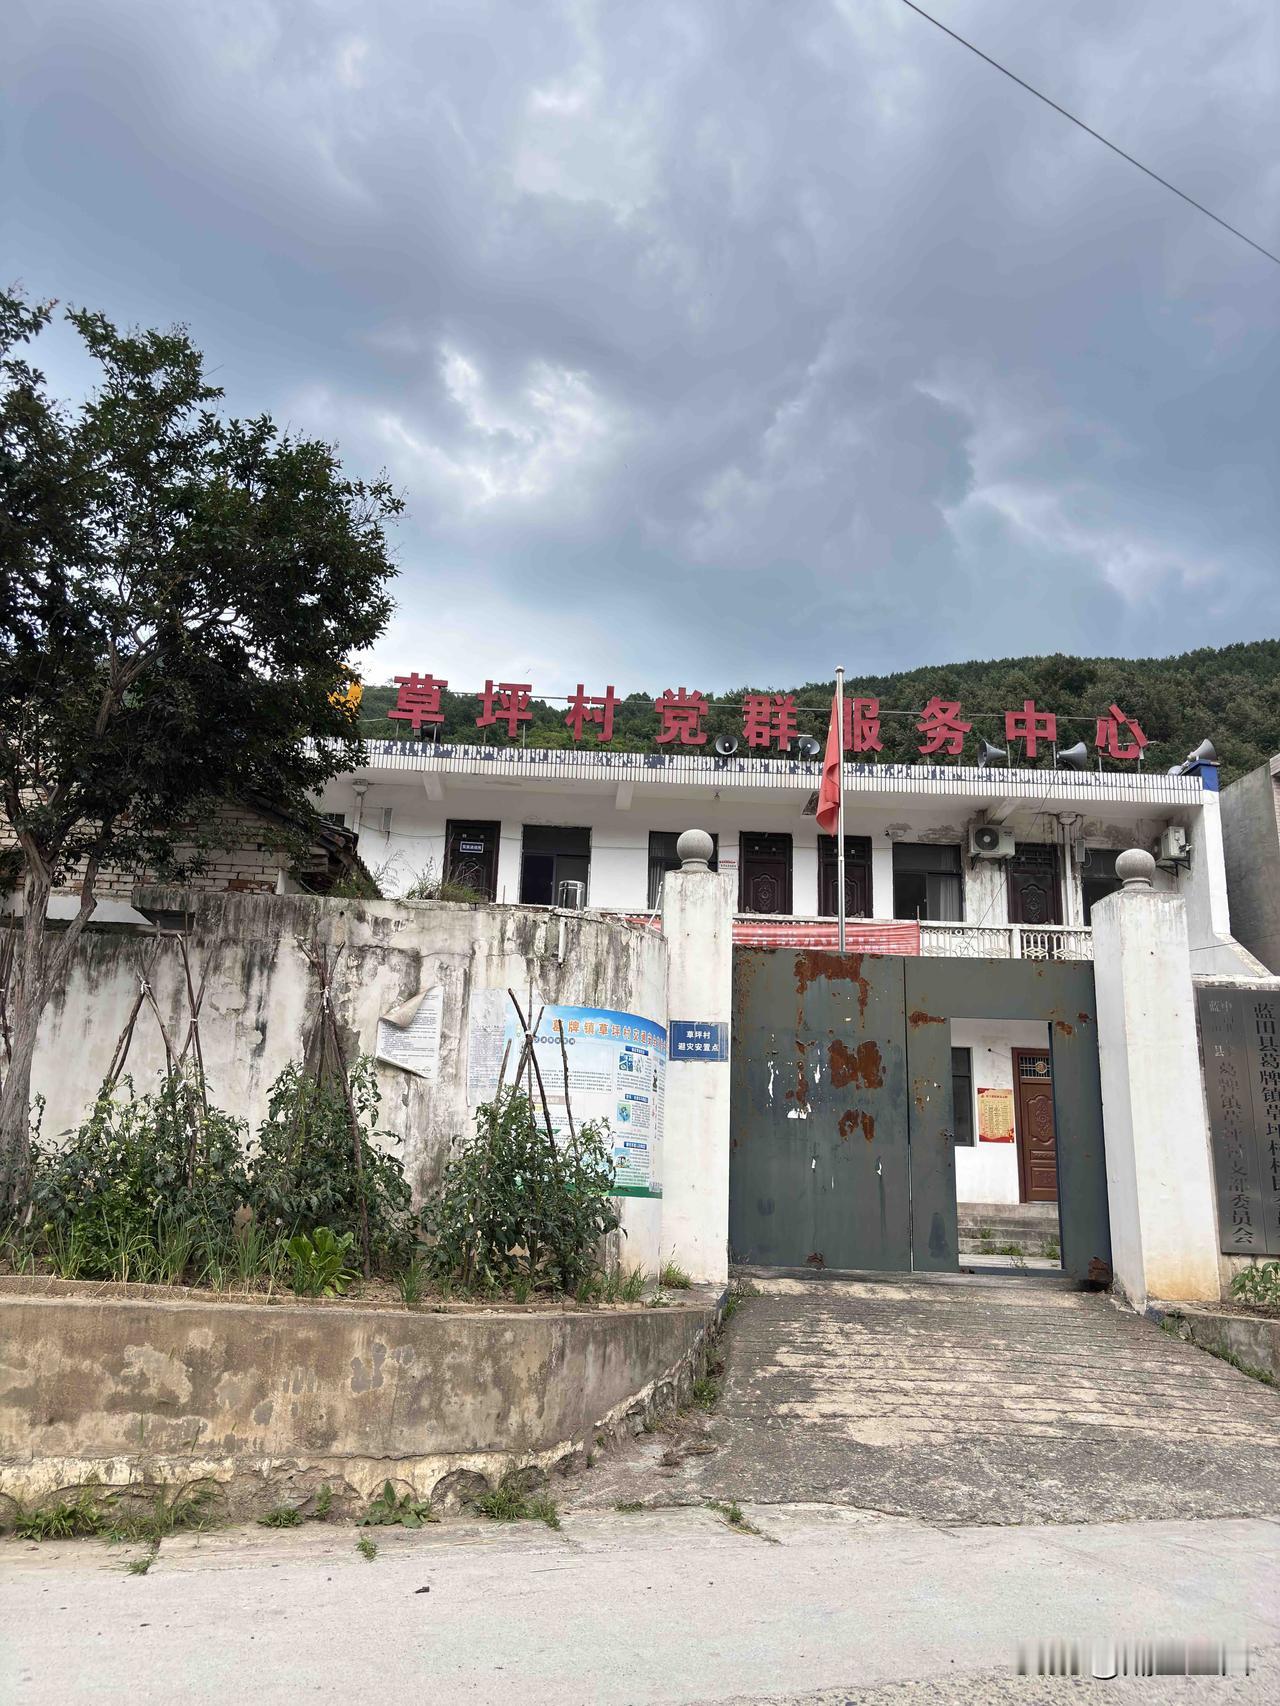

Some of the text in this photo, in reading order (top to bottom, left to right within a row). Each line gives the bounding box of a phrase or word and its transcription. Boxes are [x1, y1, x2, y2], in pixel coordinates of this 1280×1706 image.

[387, 672, 1149, 760] 草坪村党群服务中心
[686, 1031, 711, 1040] 草坪村
[678, 1042, 720, 1052] 避灾安置点
